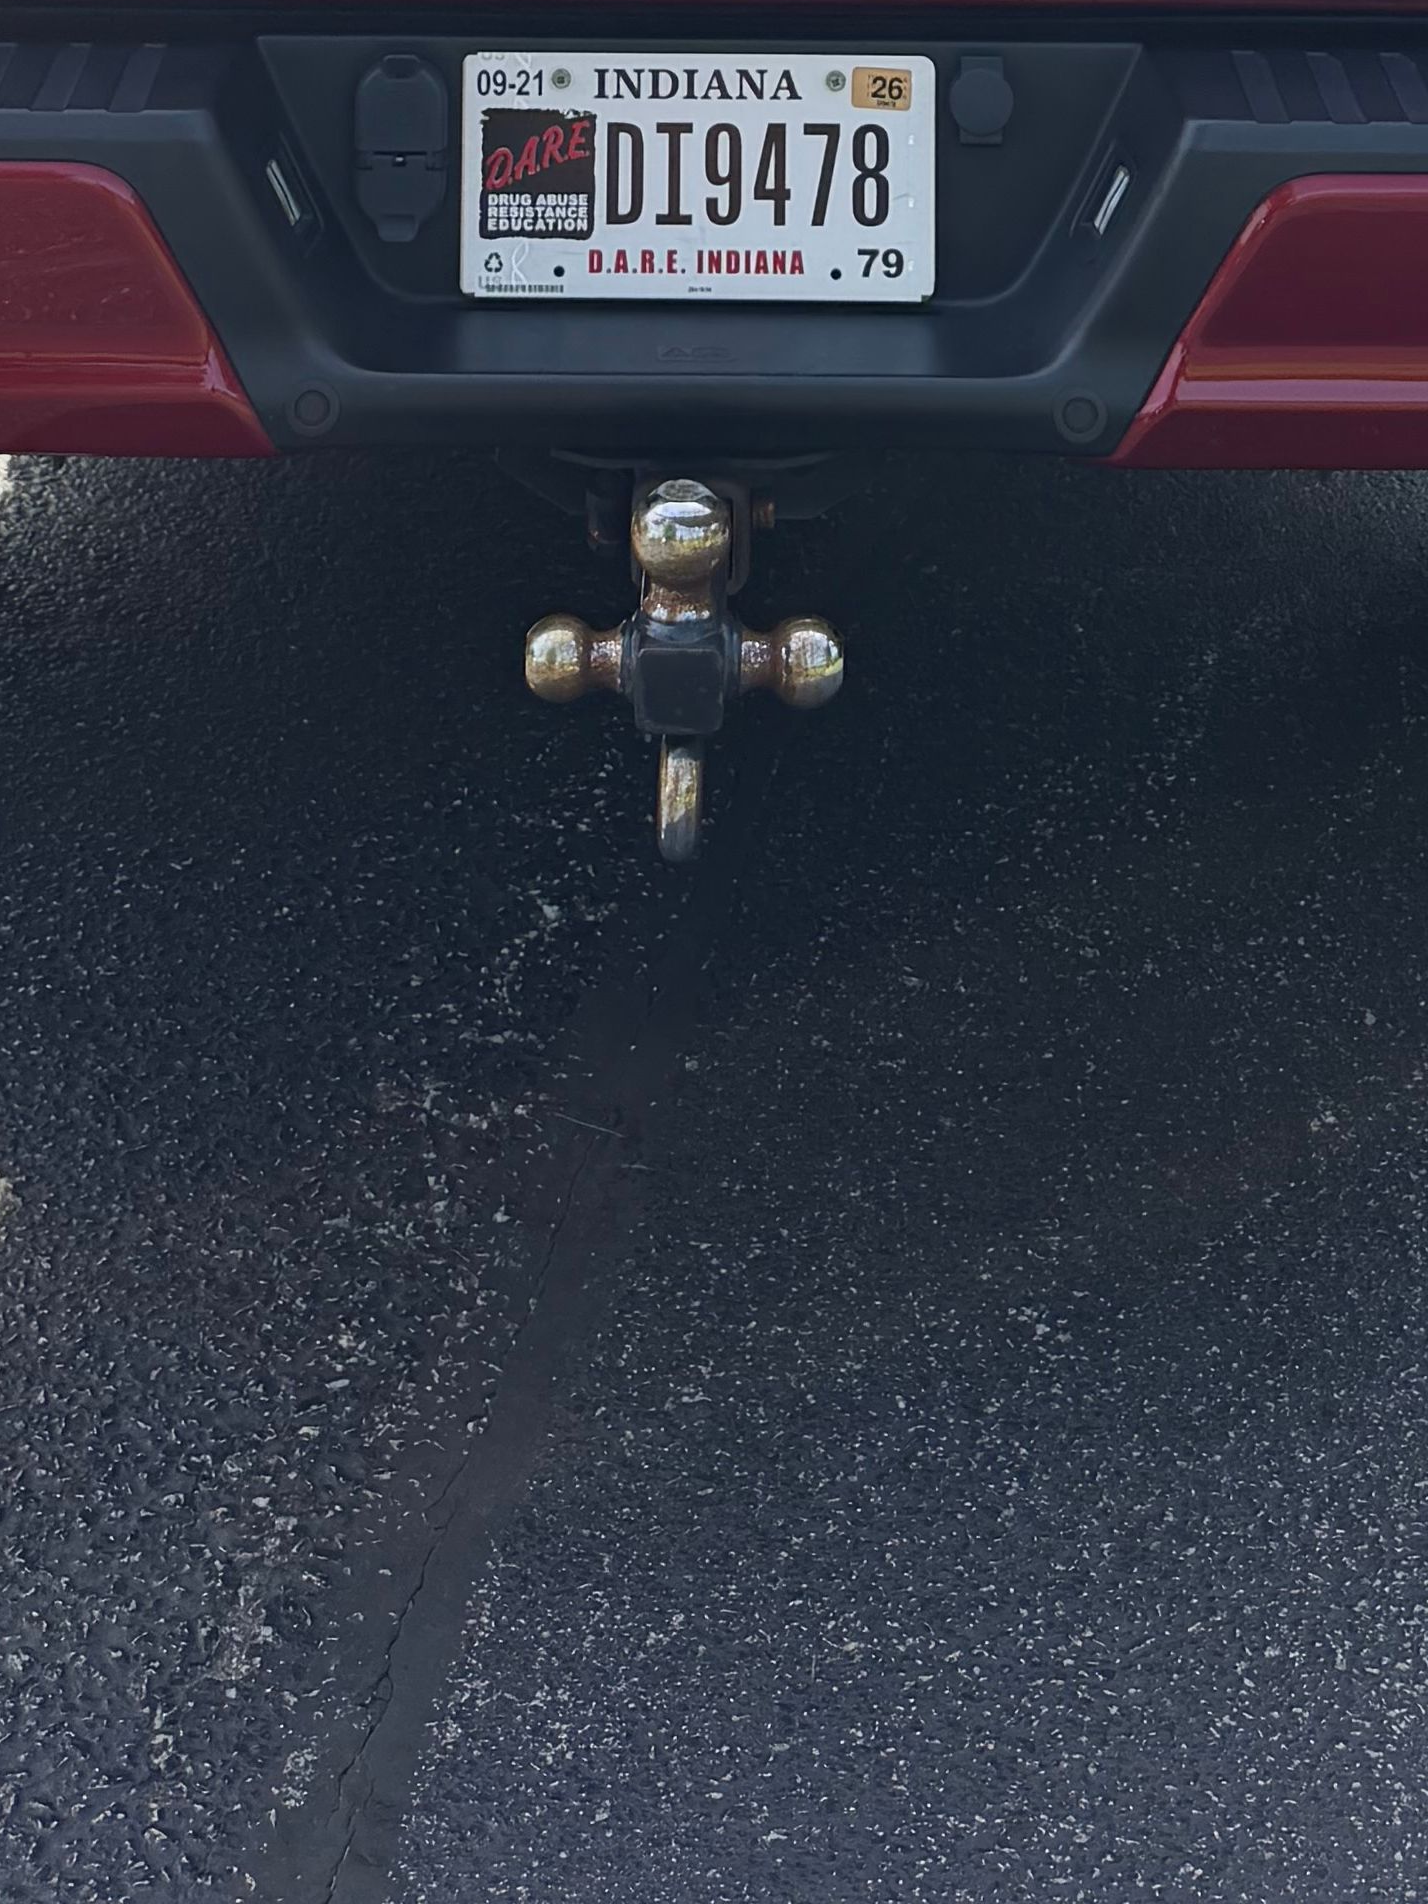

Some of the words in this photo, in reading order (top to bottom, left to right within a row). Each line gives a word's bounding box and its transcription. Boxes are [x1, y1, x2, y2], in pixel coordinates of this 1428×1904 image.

[477, 69, 544, 96] 09-21
[593, 68, 802, 100] INDIANA
[871, 75, 903, 100] 26
[485, 120, 590, 190] D.A.R.E.
[605, 121, 890, 227] DI9478
[487, 193, 532, 206] DRUG
[535, 193, 589, 206] ABUSE
[487, 206, 589, 219] RESISTANCE
[487, 218, 588, 232] EDUCATION
[588, 249, 686, 274] D.A.R.E.
[696, 249, 805, 275] INDIANA
[857, 248, 905, 279] 79
